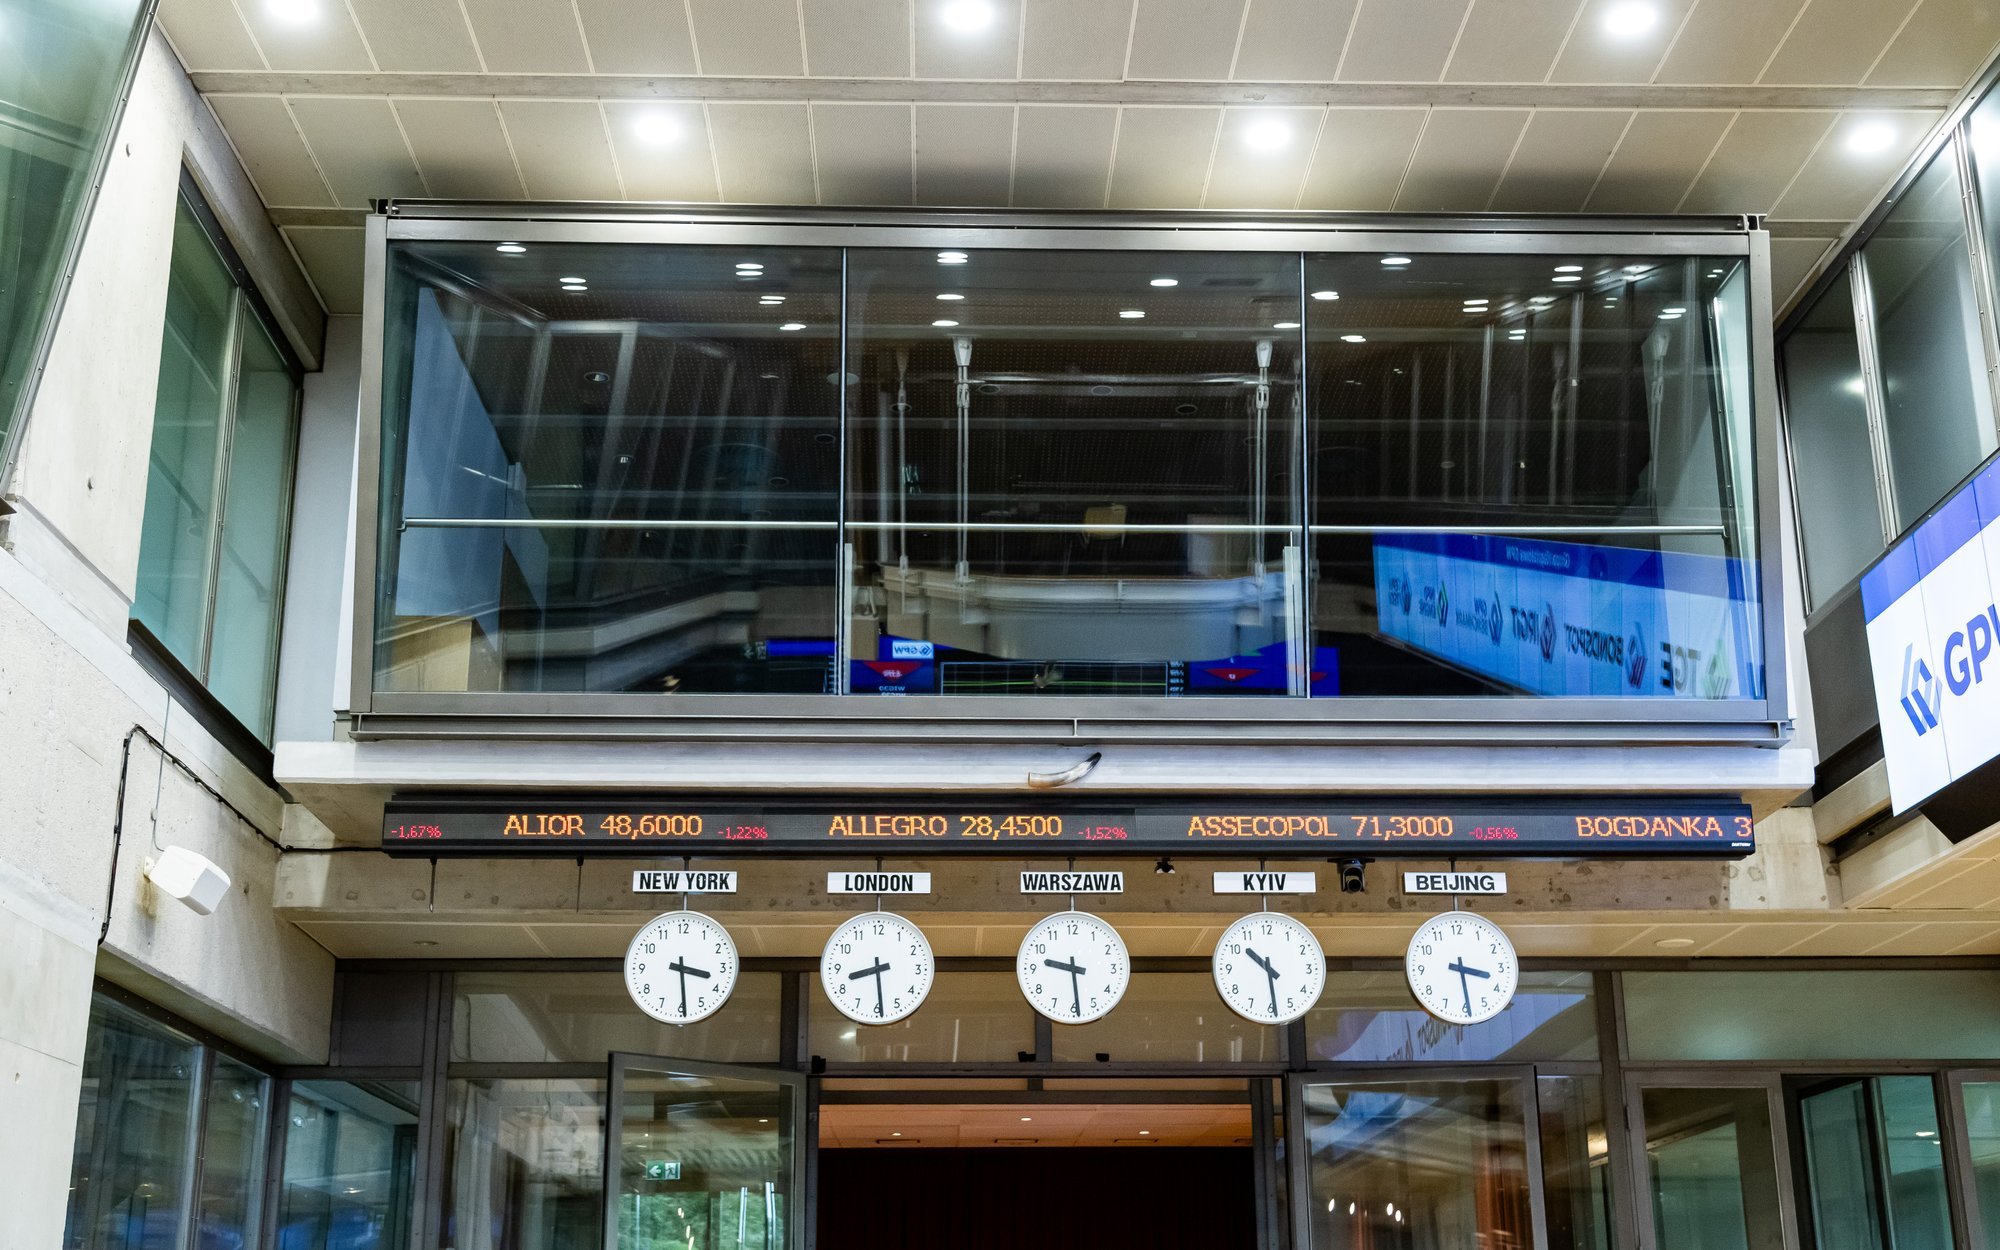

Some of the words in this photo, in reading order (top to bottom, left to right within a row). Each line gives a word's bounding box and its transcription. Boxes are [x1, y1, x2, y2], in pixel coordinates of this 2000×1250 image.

[1943, 603, 2000, 697] GP
[390, 825, 442, 839] -1,67%
[503, 814, 586, 836] ALIOR
[600, 815, 703, 840] 48,6000
[717, 826, 768, 840] -1,22%
[828, 815, 948, 836] ALLEGRO
[959, 815, 1063, 841] 28,4500
[1078, 826, 1128, 841] -1,52%
[1187, 816, 1338, 837] ASSECOPOL
[1350, 816, 1453, 841] 71,3000
[1468, 827, 1518, 841] -0,56%
[1575, 816, 1723, 837] BOGDANKA
[639, 872, 679, 890] NEW
[685, 872, 730, 890] YORK
[844, 873, 914, 892] LONDON
[1022, 873, 1122, 891] WARSZAWA
[1243, 873, 1287, 891] KYIV
[1415, 874, 1495, 891] BEIJING
[678, 923, 689, 935] 12
[873, 925, 884, 936] 12
[1067, 924, 1078, 936] 12
[1261, 925, 1273, 936] 12
[1451, 925, 1463, 936] 12
[659, 930, 668, 940] 11
[854, 930, 863, 941] 11
[1048, 930, 1057, 941] 11
[1243, 931, 1252, 941] 11
[1433, 931, 1443, 942] 11
[644, 943, 656, 955] 10
[715, 943, 722, 954] 2
[840, 944, 851, 955] 10
[910, 945, 917, 956] 2
[1035, 944, 1046, 955] 10
[1105, 945, 1111, 956] 2
[1230, 944, 1241, 955] 10
[1299, 945, 1306, 956] 2
[1421, 945, 1432, 956] 10
[1490, 944, 1497, 955] 2
[638, 964, 646, 975] 9
[719, 963, 726, 974] 3
[834, 964, 841, 975] 9
[915, 965, 922, 975] 3
[1029, 964, 1037, 975] 9
[1110, 964, 1117, 975] 3
[1225, 964, 1232, 975] 9
[1306, 964, 1313, 975] 3
[1418, 965, 1425, 976] 9
[1498, 963, 1505, 974] 3
[643, 984, 651, 995] 8
[712, 984, 719, 993] 4
[839, 984, 846, 995] 8
[907, 986, 915, 995] 4
[1035, 984, 1043, 995] 8
[1104, 985, 1111, 994] 4
[1232, 984, 1239, 995] 8
[1300, 985, 1307, 994] 4
[1425, 985, 1433, 996] 8
[1493, 984, 1500, 993] 4
[659, 998, 665, 1009] 7
[698, 997, 705, 1008] 5
[855, 998, 861, 1009] 7
[894, 998, 901, 1009] 5
[1051, 998, 1058, 1009] 7
[1090, 998, 1097, 1009] 5
[1248, 998, 1254, 1009] 7
[1287, 998, 1294, 1009] 5
[1442, 998, 1448, 1010] 7
[1481, 997, 1488, 1008] 5
[677, 1003, 685, 1014] 6
[873, 1003, 881, 1014] 6
[1070, 1003, 1078, 1014] 6
[1267, 1003, 1275, 1014] 6
[1462, 1003, 1469, 1014] 6
